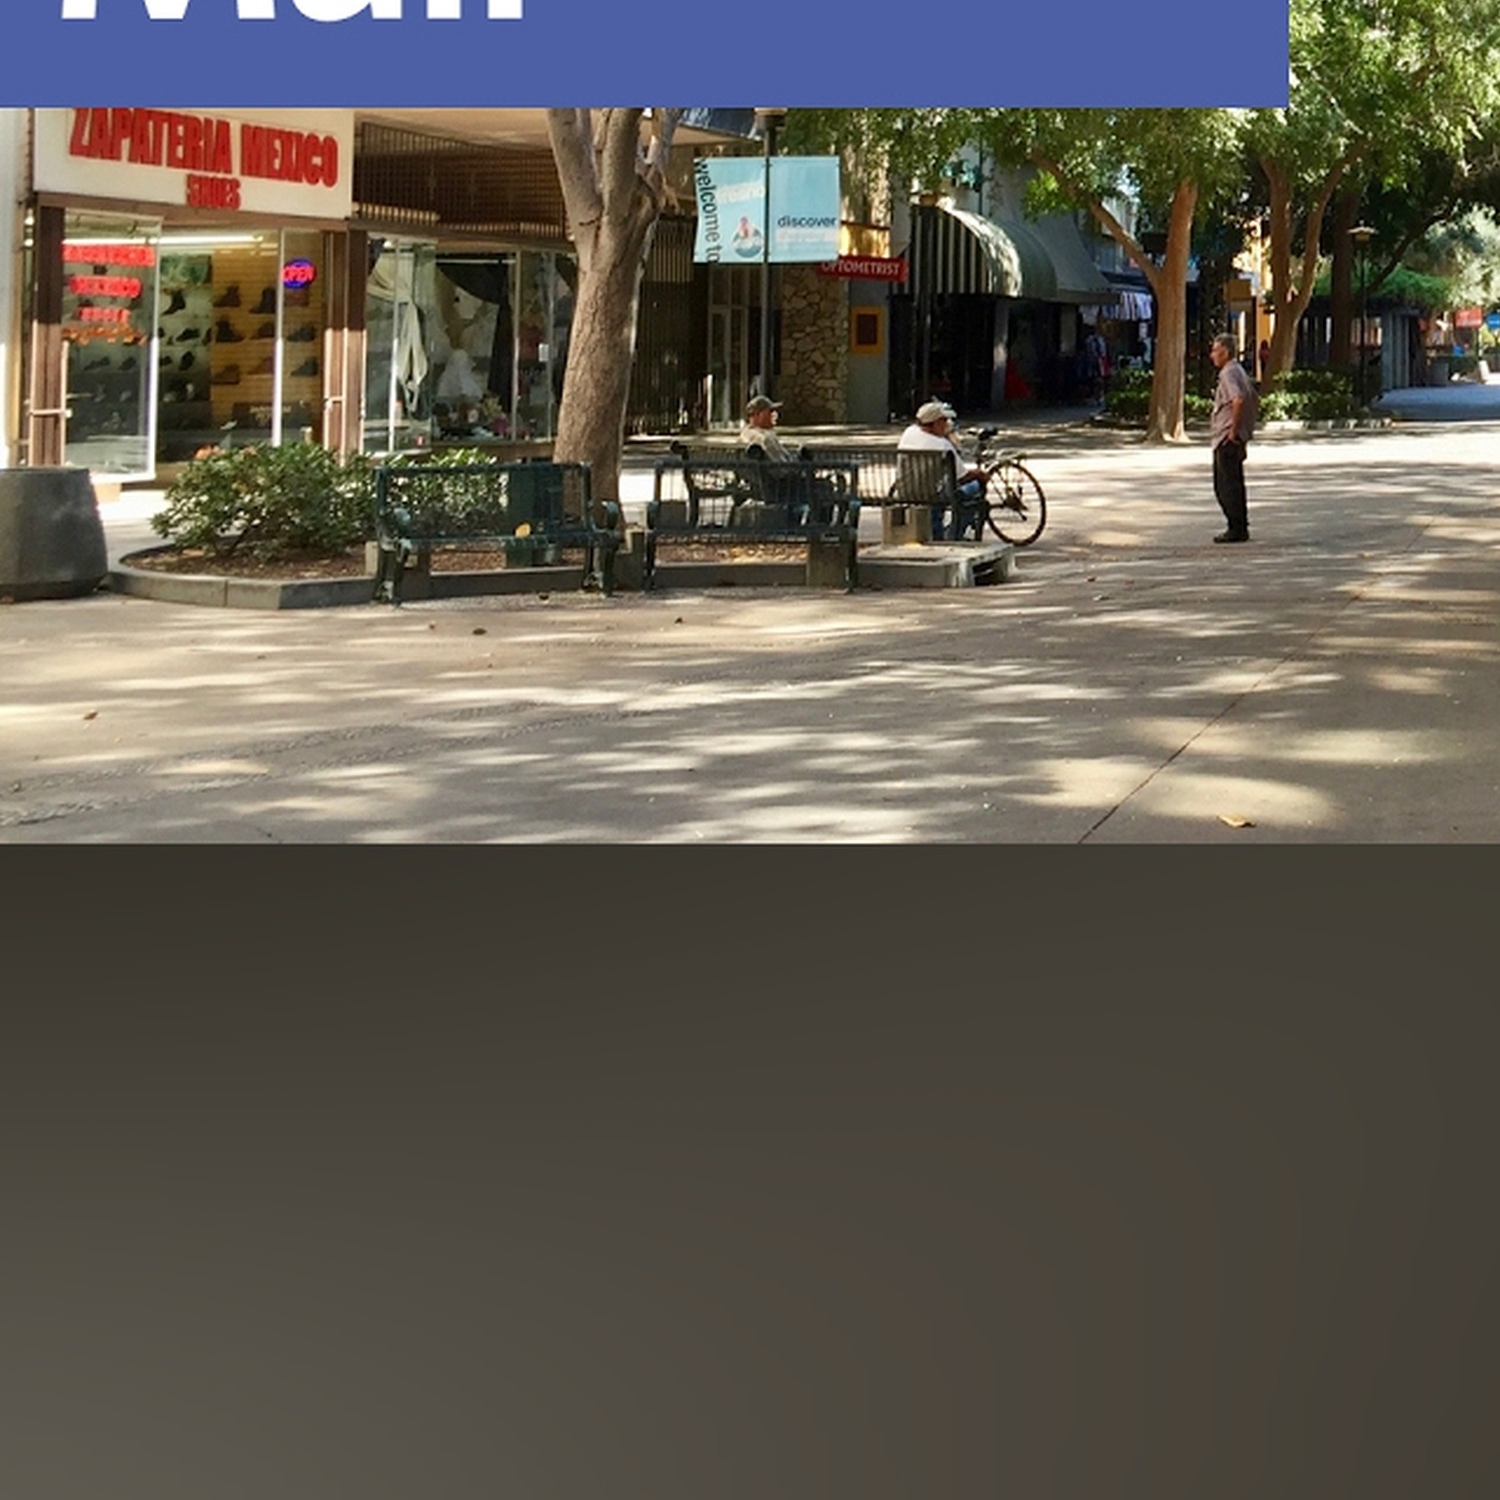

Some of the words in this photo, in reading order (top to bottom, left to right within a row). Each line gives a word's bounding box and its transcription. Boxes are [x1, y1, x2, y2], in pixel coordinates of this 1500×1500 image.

[69, 107, 233, 175] ZAPATERIA
[240, 123, 339, 188] MEXICO
[693, 159, 721, 243] welcome
[777, 215, 837, 228] discover
[705, 244, 723, 264] to
